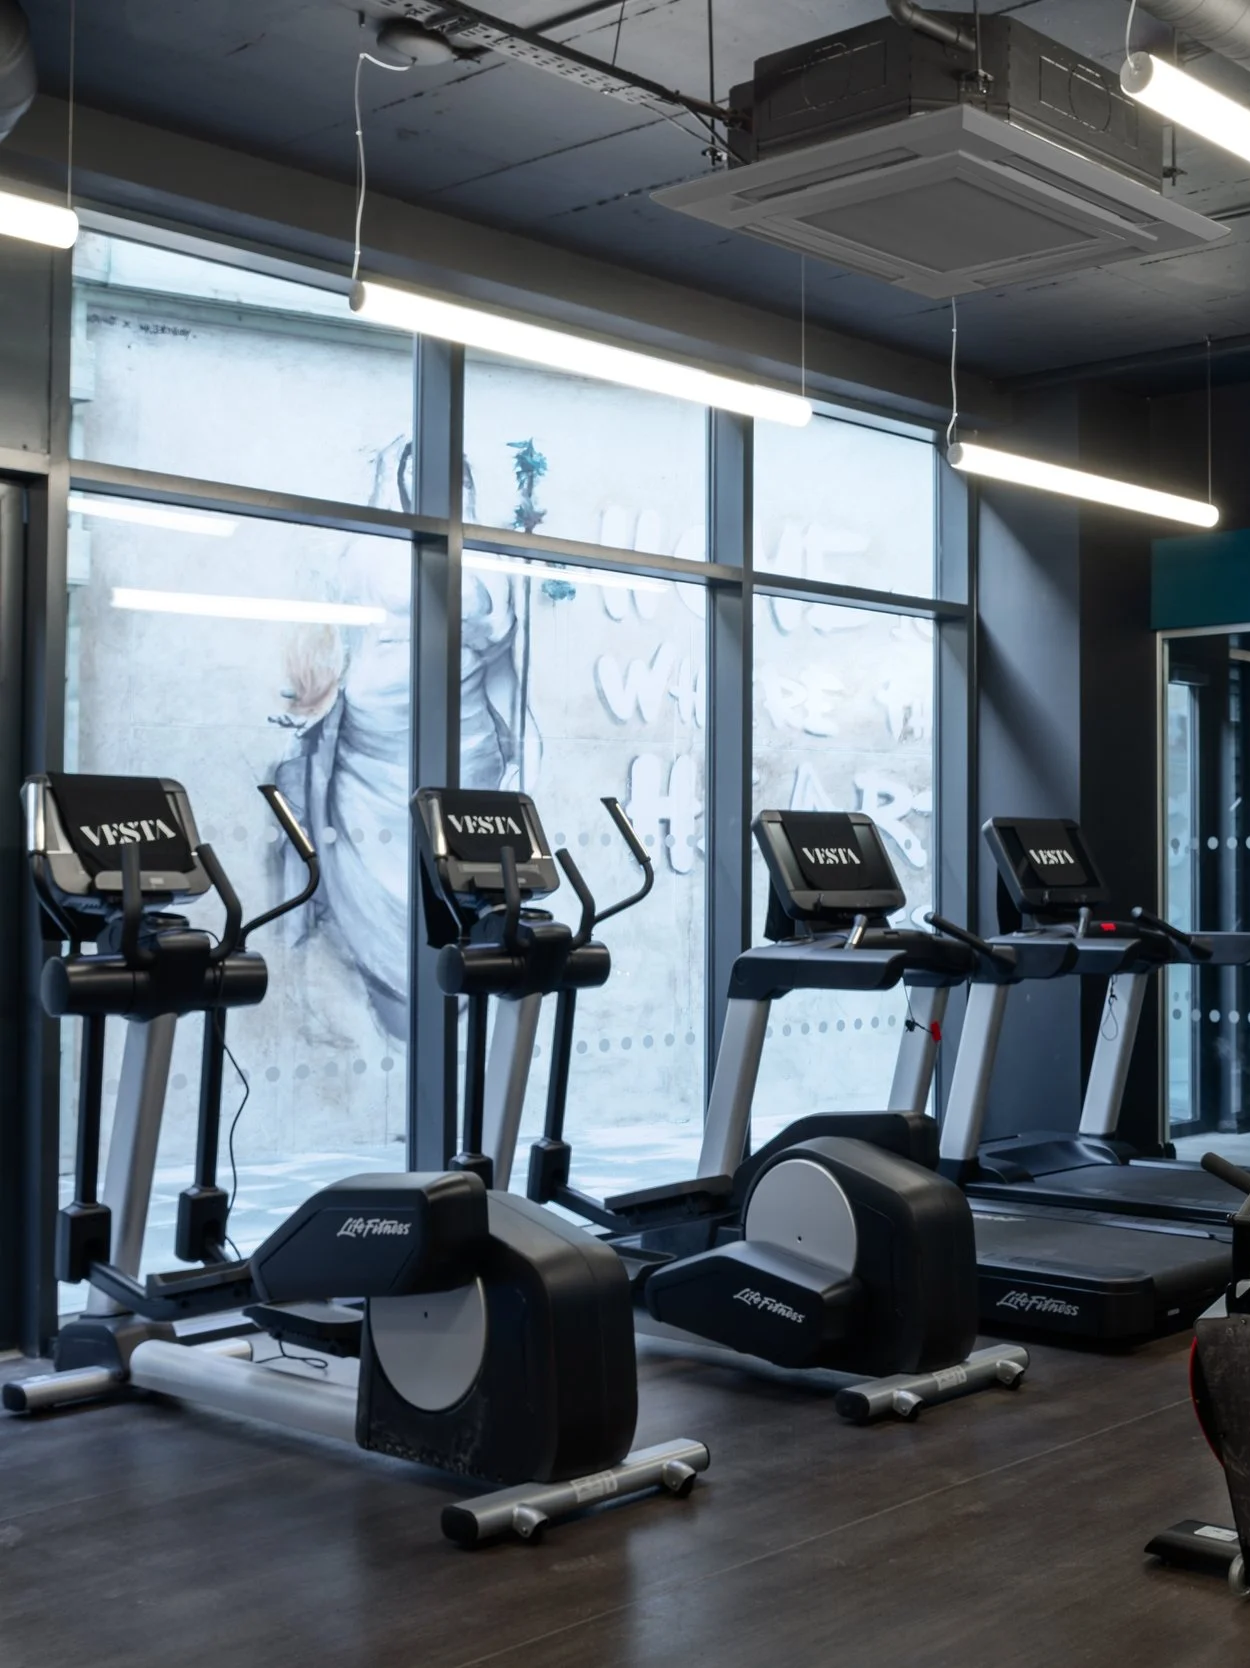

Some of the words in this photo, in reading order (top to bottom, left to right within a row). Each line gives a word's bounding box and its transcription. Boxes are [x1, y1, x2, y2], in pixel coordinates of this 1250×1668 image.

[80, 818, 176, 846] VESTA
[447, 814, 522, 834] VESTA
[802, 847, 861, 865] VESTA
[1029, 849, 1075, 865] VESTA
